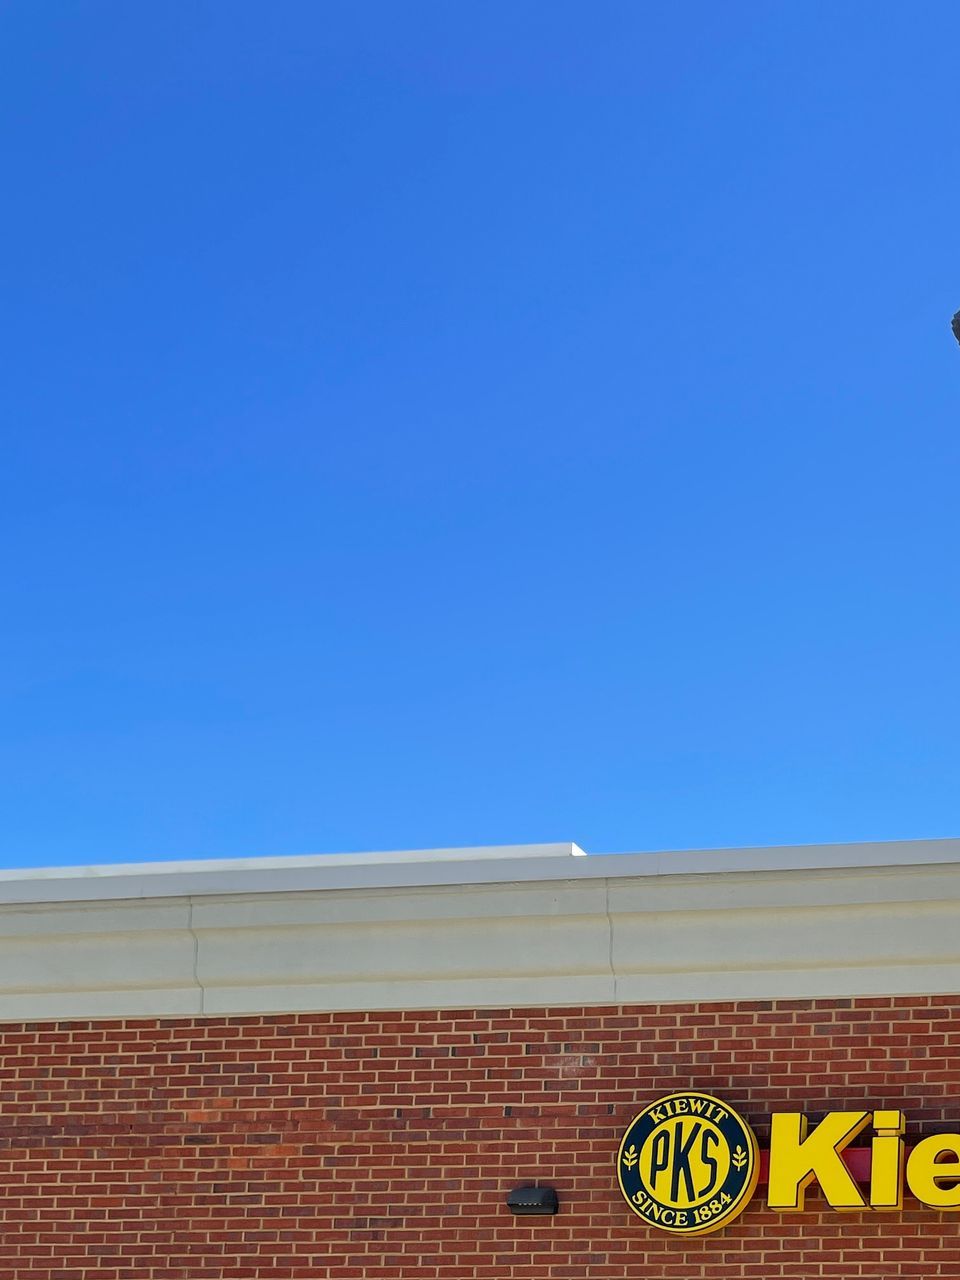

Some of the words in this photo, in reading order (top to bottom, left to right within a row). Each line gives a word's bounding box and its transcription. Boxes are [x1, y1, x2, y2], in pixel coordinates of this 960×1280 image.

[648, 1098, 729, 1125] KIEWIT
[650, 1121, 719, 1203] PKS
[632, 1190, 689, 1226] SINCE
[693, 1191, 733, 1224] 1884
